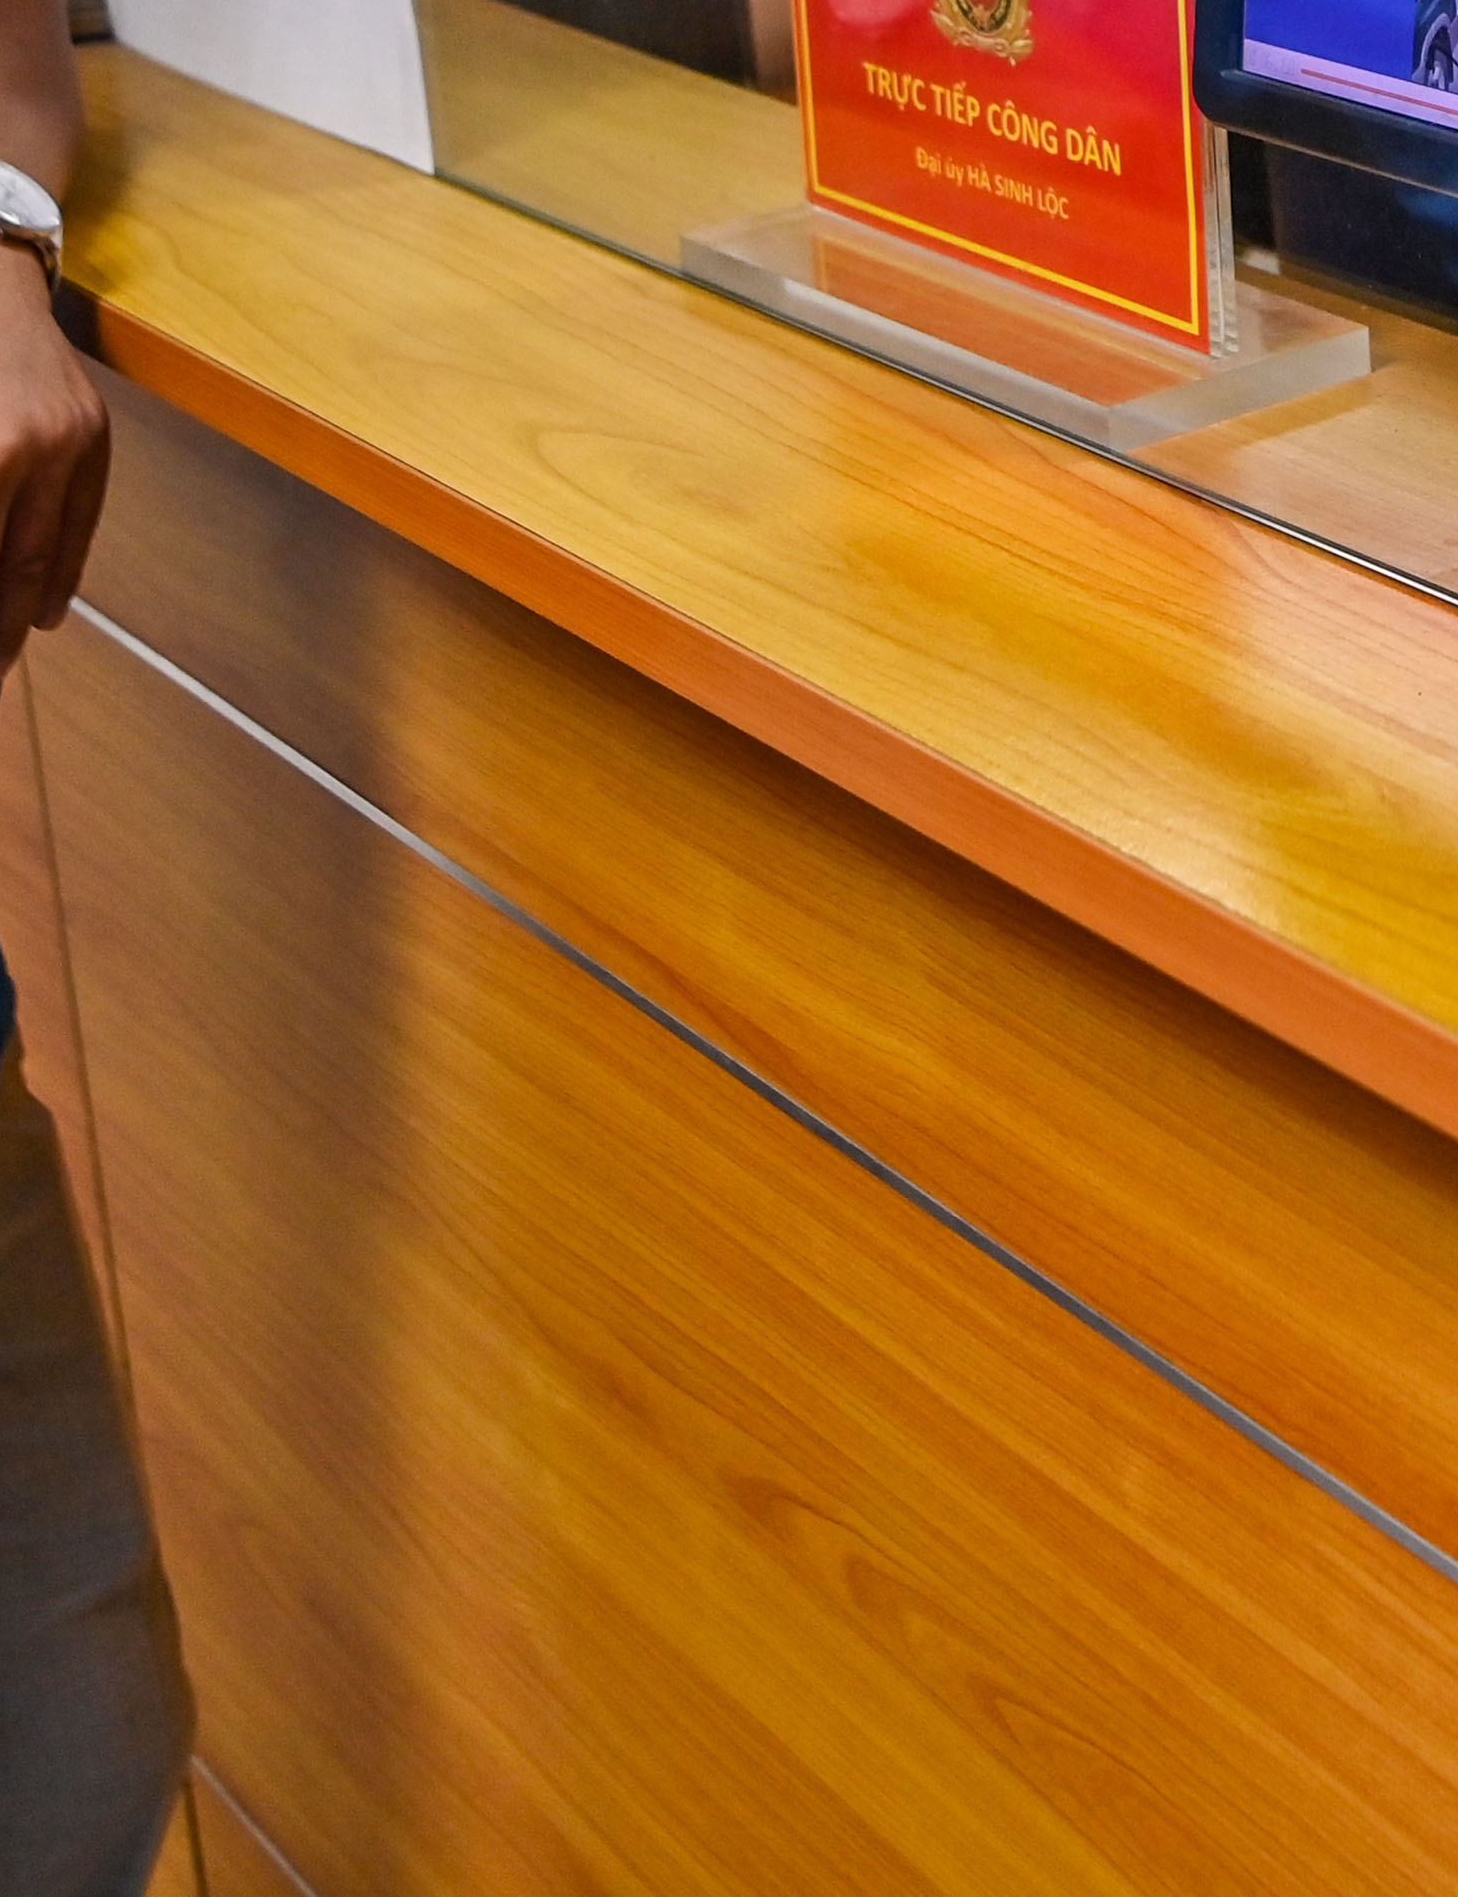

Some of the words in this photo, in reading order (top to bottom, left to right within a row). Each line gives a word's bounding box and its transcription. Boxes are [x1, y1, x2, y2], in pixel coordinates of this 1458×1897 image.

[863, 62, 927, 112] TRỰC
[929, 81, 981, 128] TIẾP
[987, 99, 1059, 156] CÔNG
[1065, 124, 1122, 177] DÂN
[915, 146, 943, 178] Đại
[967, 162, 993, 194] HÀ
[994, 173, 1034, 208] SINH
[1036, 185, 1071, 220] LỘC
